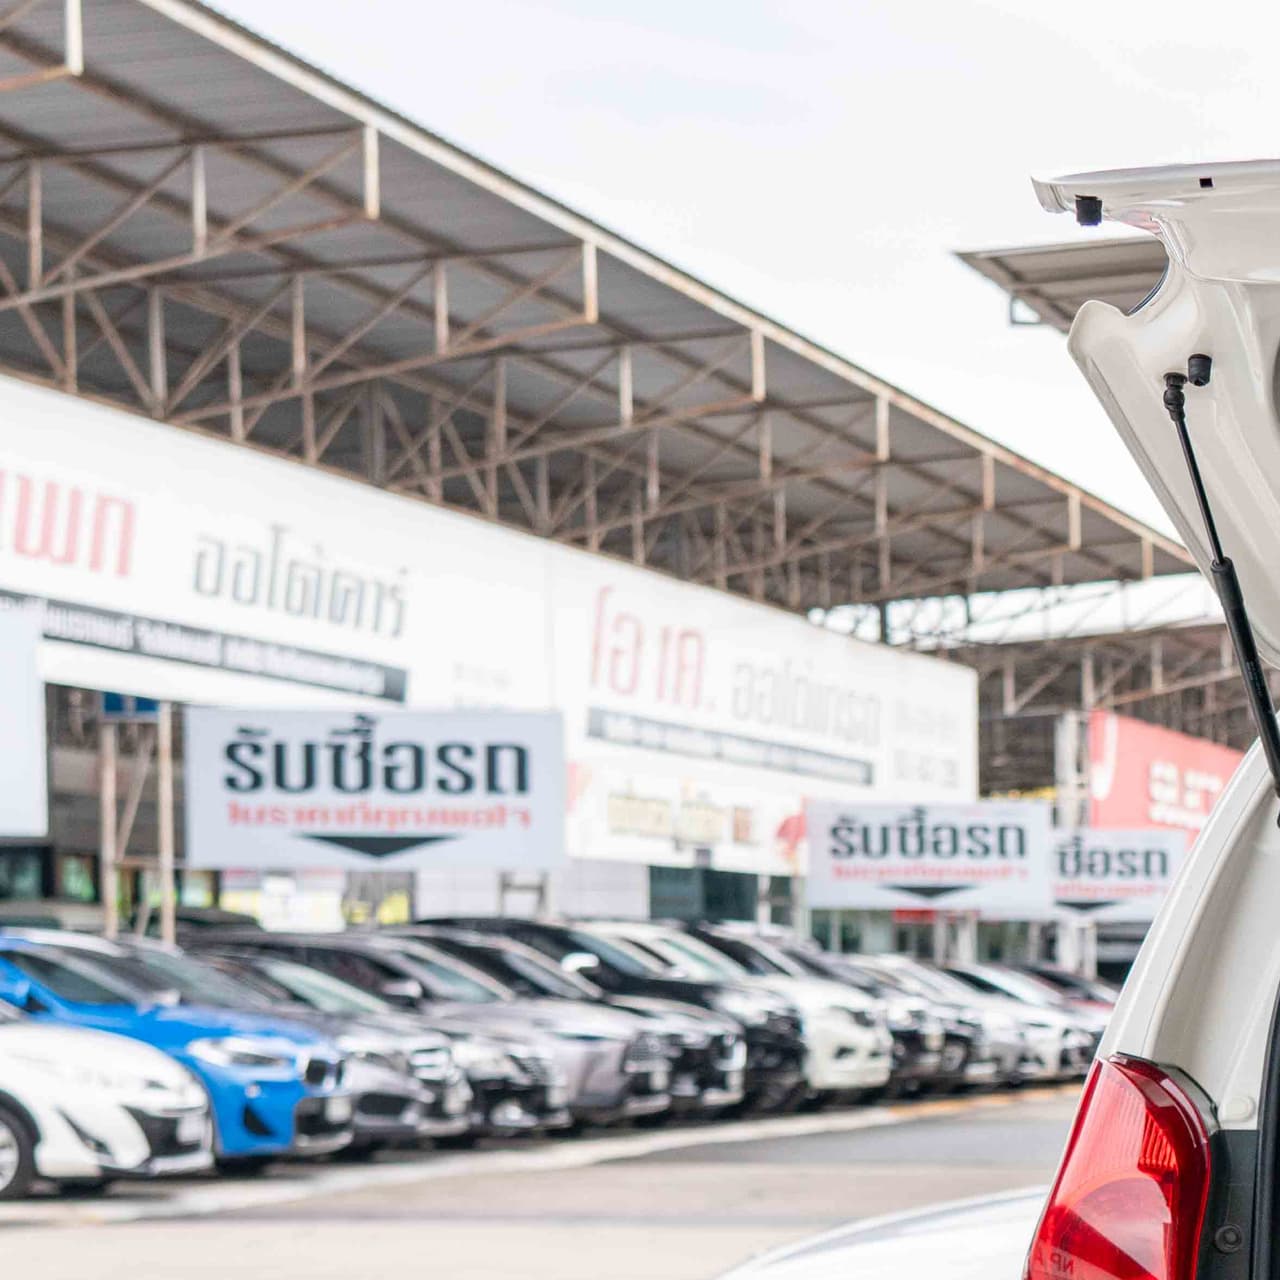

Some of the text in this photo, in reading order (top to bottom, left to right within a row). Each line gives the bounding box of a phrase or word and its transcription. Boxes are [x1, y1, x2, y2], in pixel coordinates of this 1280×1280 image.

[224, 713, 530, 794] รับซื้อรถ
[829, 805, 1027, 860] รับซื้อรถ
